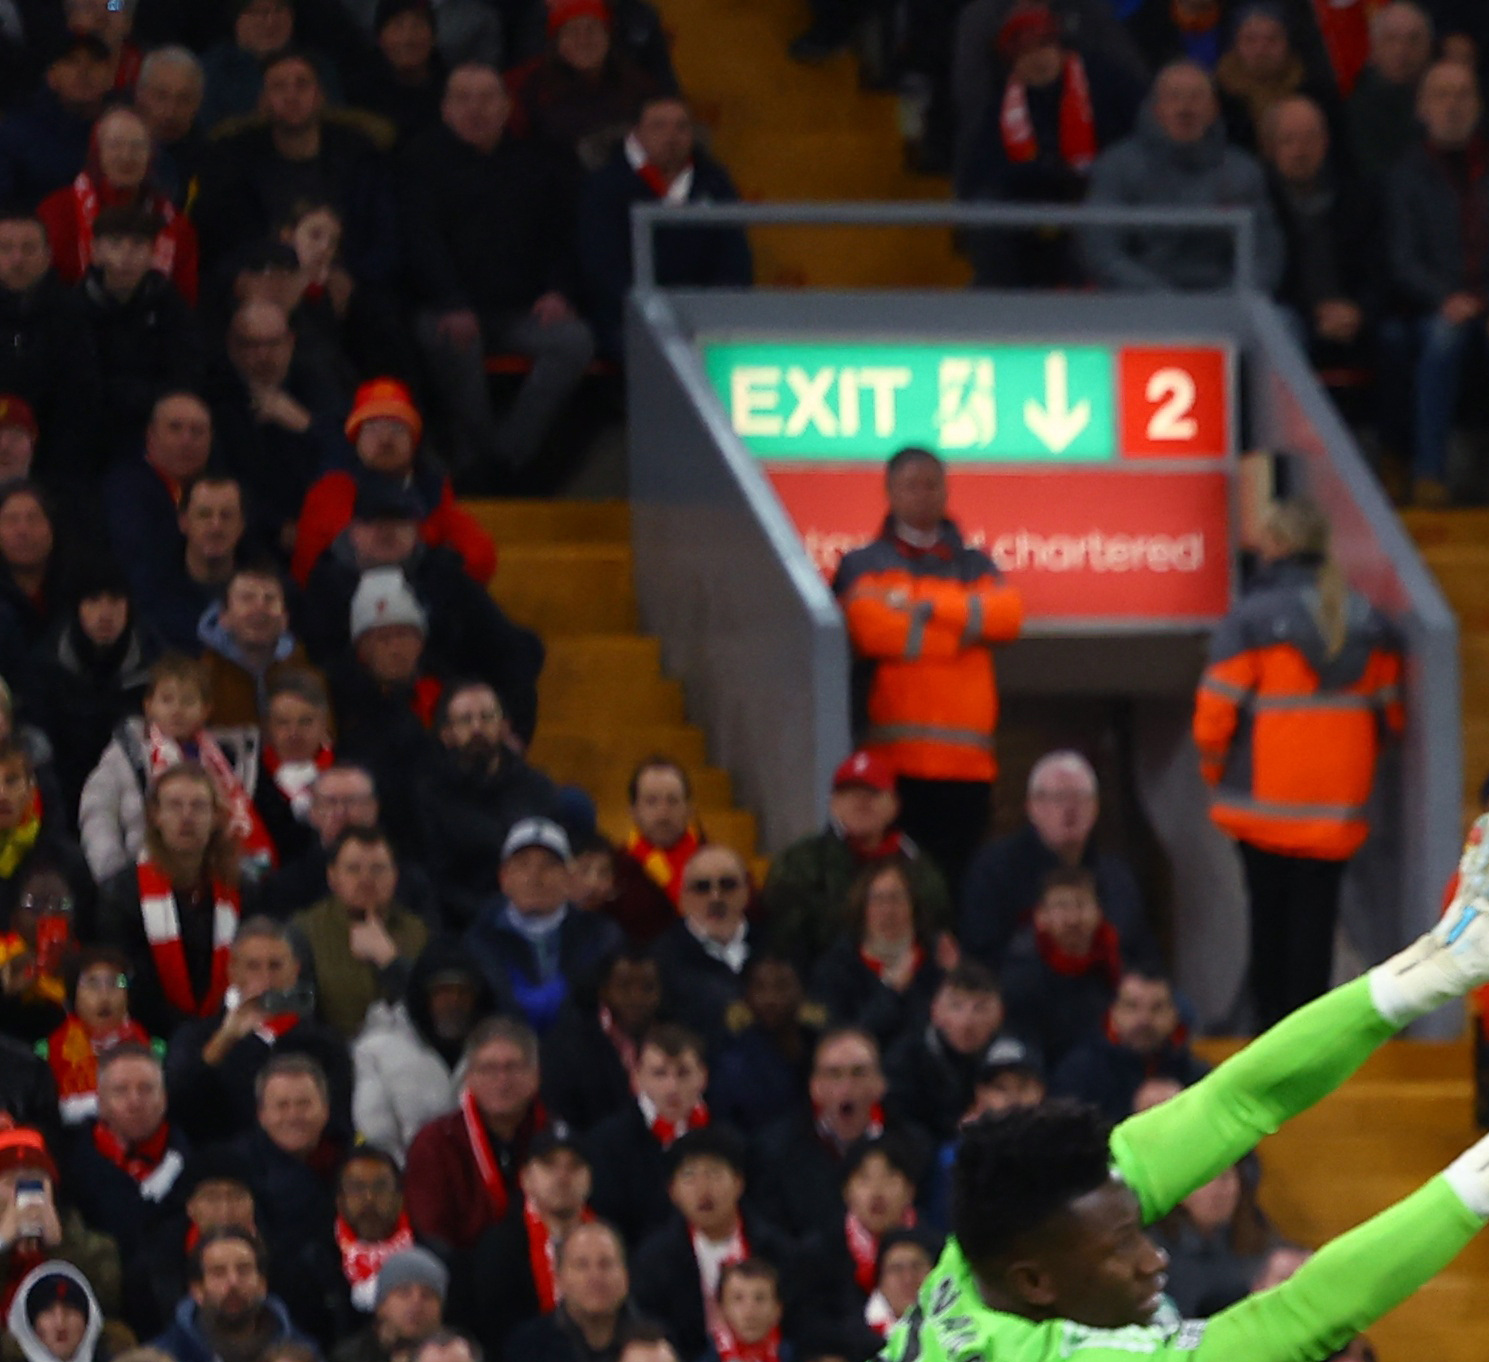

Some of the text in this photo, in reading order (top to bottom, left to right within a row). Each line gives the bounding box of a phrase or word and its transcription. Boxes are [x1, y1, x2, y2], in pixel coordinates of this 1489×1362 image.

[731, 366, 911, 437] EXIT
[1146, 367, 1198, 441] 2
[992, 528, 1205, 573] chartered
